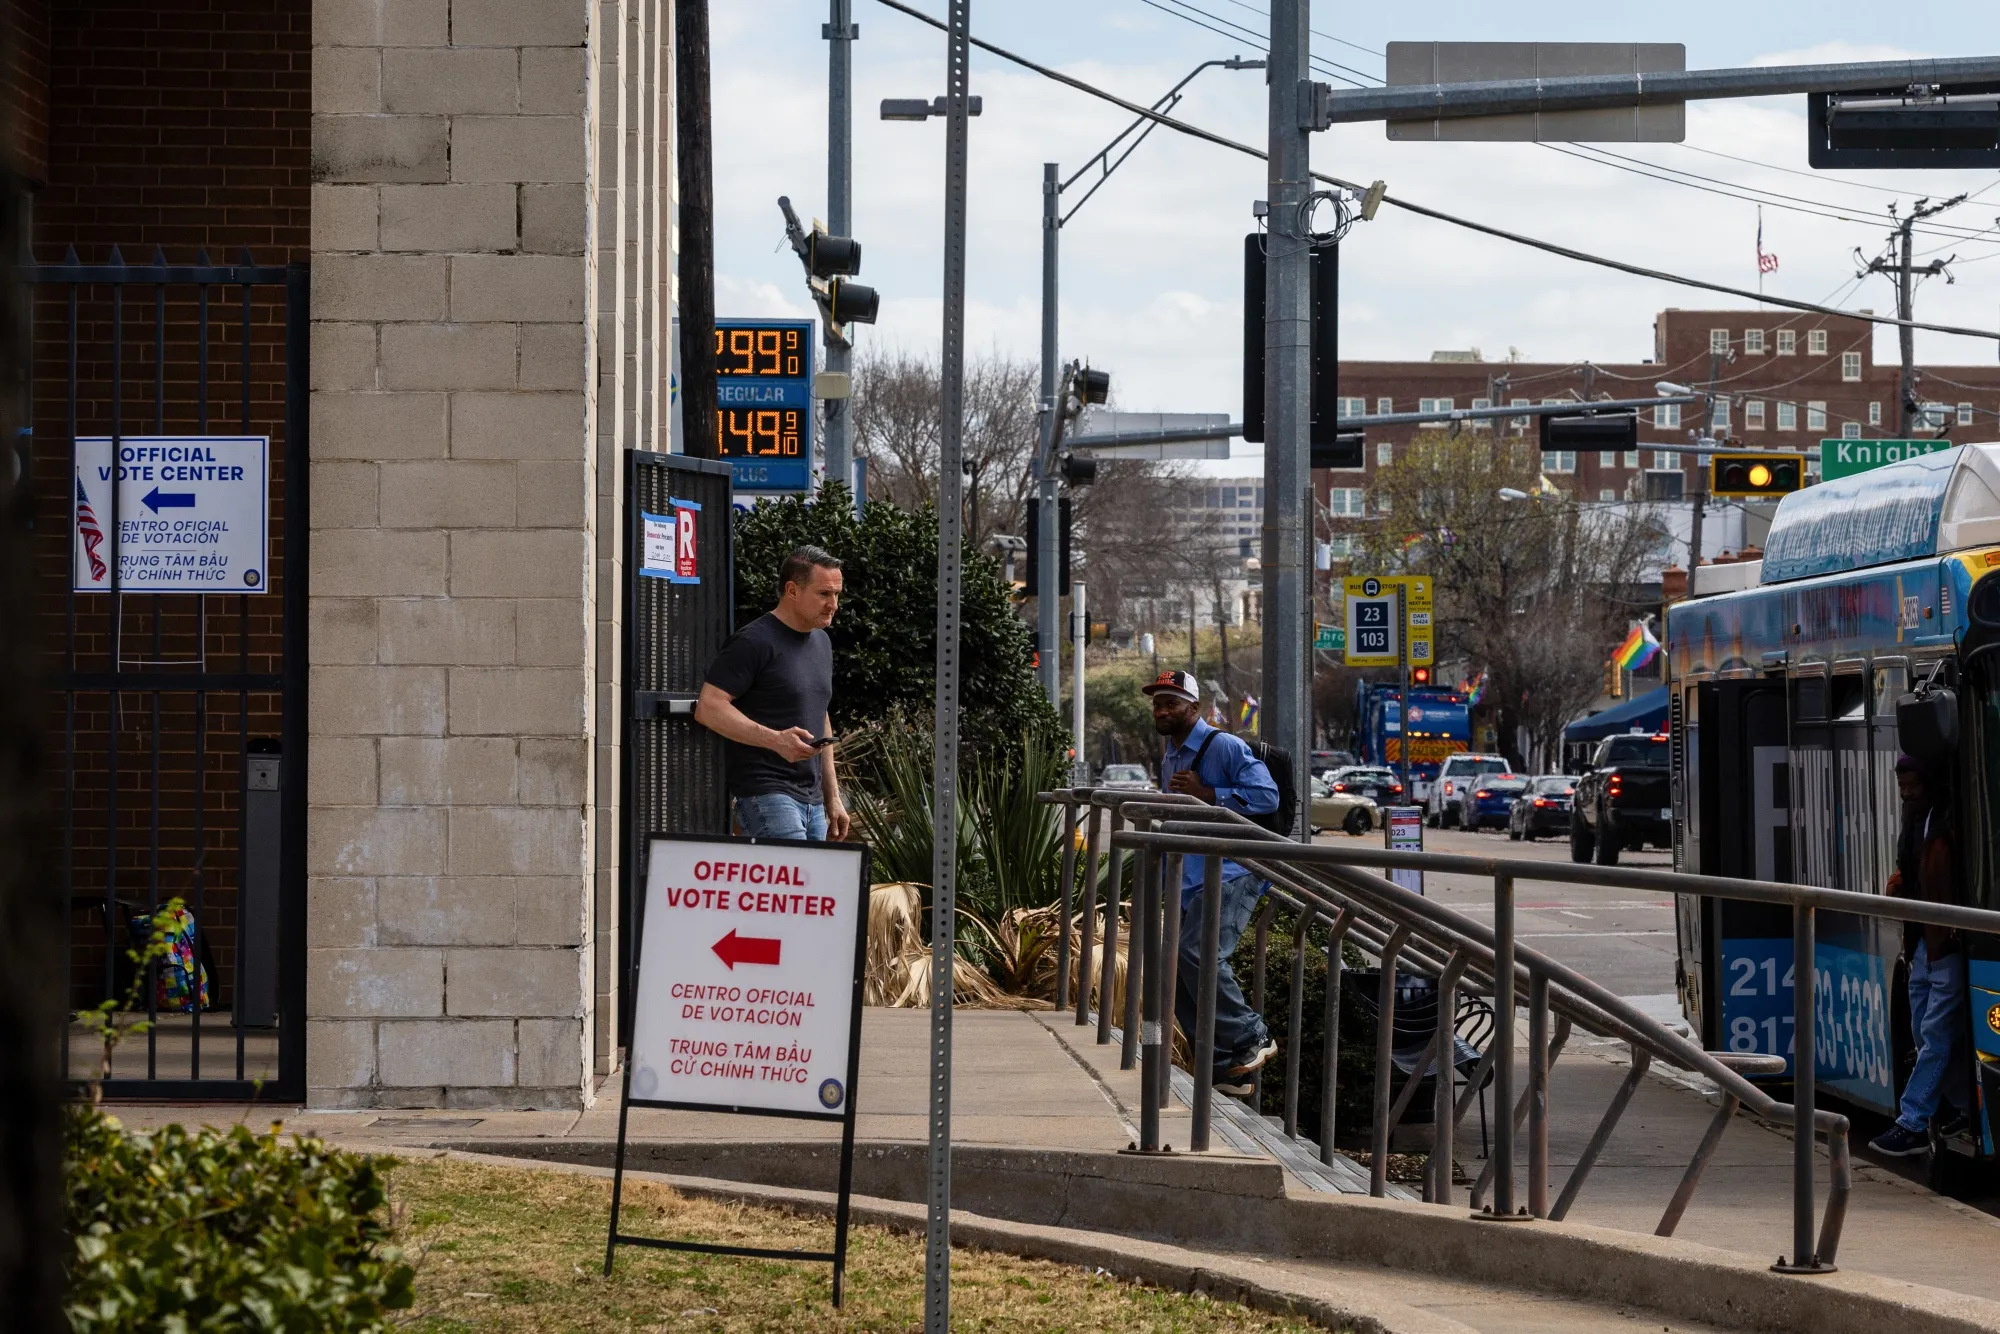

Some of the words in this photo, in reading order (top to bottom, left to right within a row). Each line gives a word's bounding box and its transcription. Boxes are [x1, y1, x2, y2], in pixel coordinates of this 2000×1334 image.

[717, 386, 784, 401] REGULAR
[120, 447, 216, 462] OFFICIAL
[98, 466, 155, 481] VOTE
[160, 466, 244, 481] CENTER
[173, 520, 229, 532] OFICIAL
[121, 533, 140, 544] DE
[144, 531, 219, 544] VOTACIÓN
[680, 511, 694, 558] R
[165, 552, 195, 566] TÂM
[199, 550, 228, 566] BẦU
[138, 567, 182, 581] CHÍNH
[187, 567, 226, 581] THỨC
[1364, 607, 1380, 621] 23
[1361, 632, 1384, 646] 103
[694, 861, 804, 886] OFFICIAL
[667, 888, 730, 910] VOTE
[738, 891, 836, 916] CENTER
[671, 983, 741, 1002] CENTRO
[746, 988, 815, 1007] OFICIAL
[682, 1004, 703, 1020] DE
[710, 1006, 802, 1027] VOTACIÓN
[1814, 967, 1888, 1088] 33-3333
[669, 1039, 727, 1057] TRUNG
[734, 1041, 770, 1060] TÂM
[776, 1040, 811, 1063] BẦU
[671, 1055, 697, 1075] CỬ
[701, 1061, 754, 1080] CHÍNH
[760, 1063, 808, 1084] THỨC
